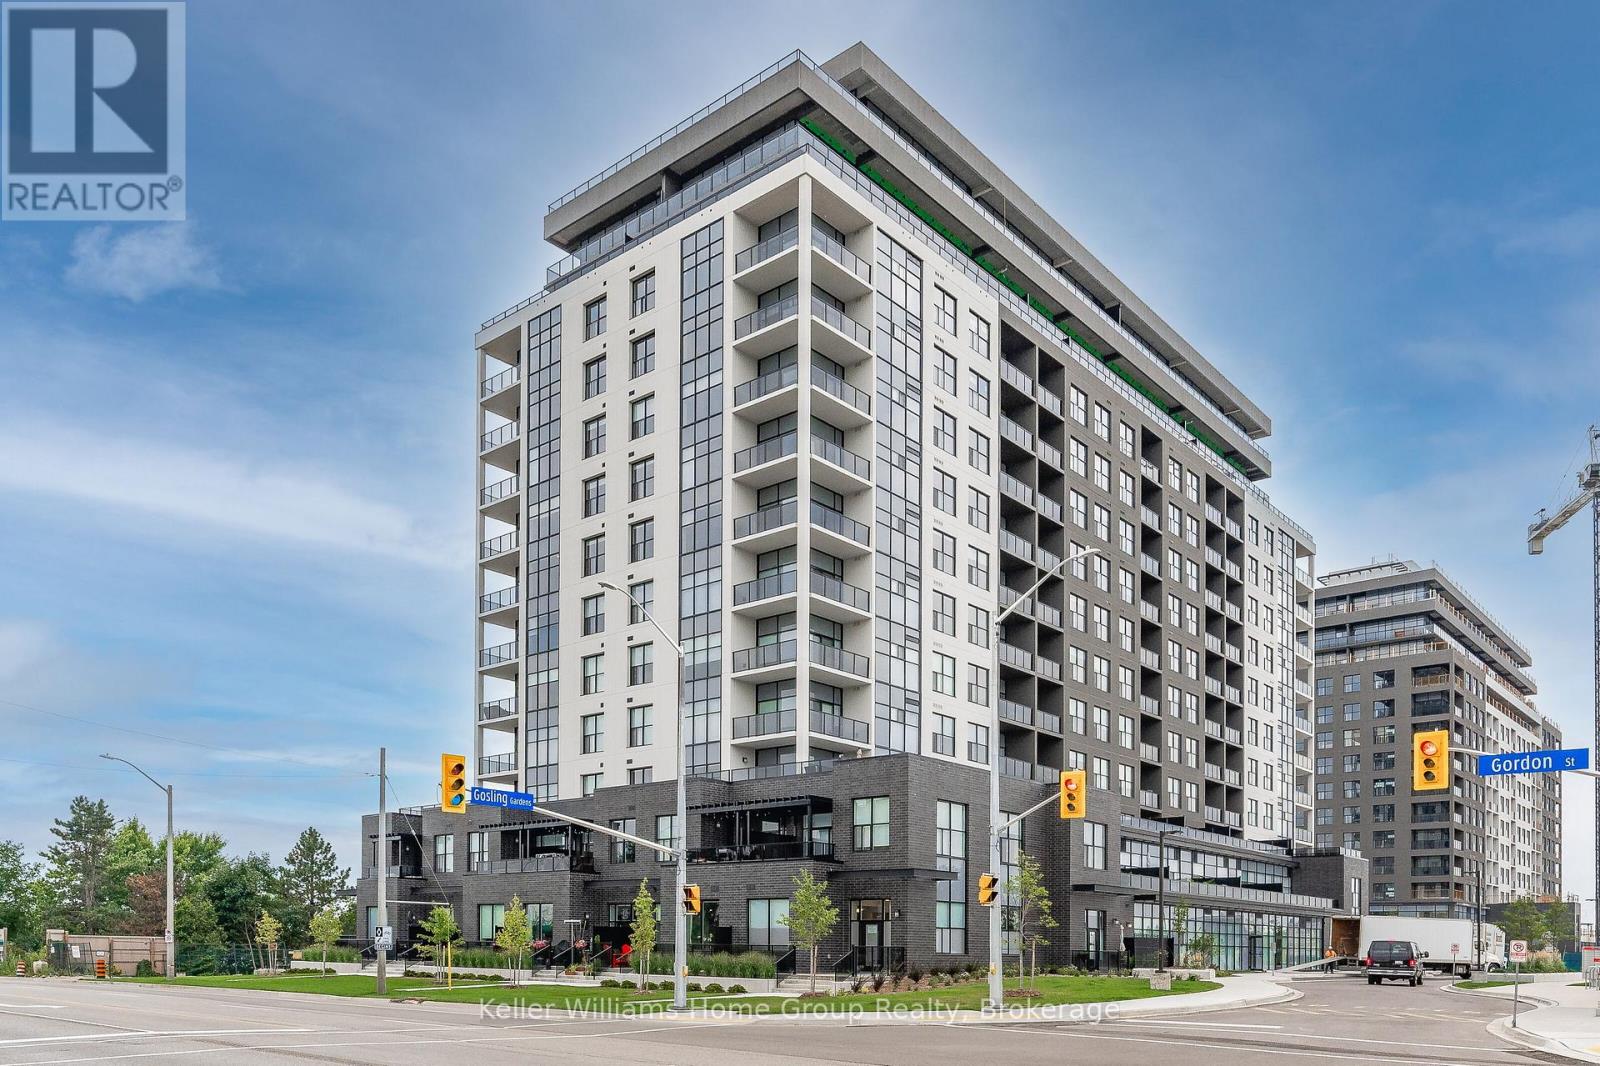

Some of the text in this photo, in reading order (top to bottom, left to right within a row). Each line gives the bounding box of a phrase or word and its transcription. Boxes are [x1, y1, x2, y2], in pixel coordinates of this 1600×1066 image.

[1491, 755, 1575, 772] Gordon St
[473, 789, 532, 806] Gosling Gardens
